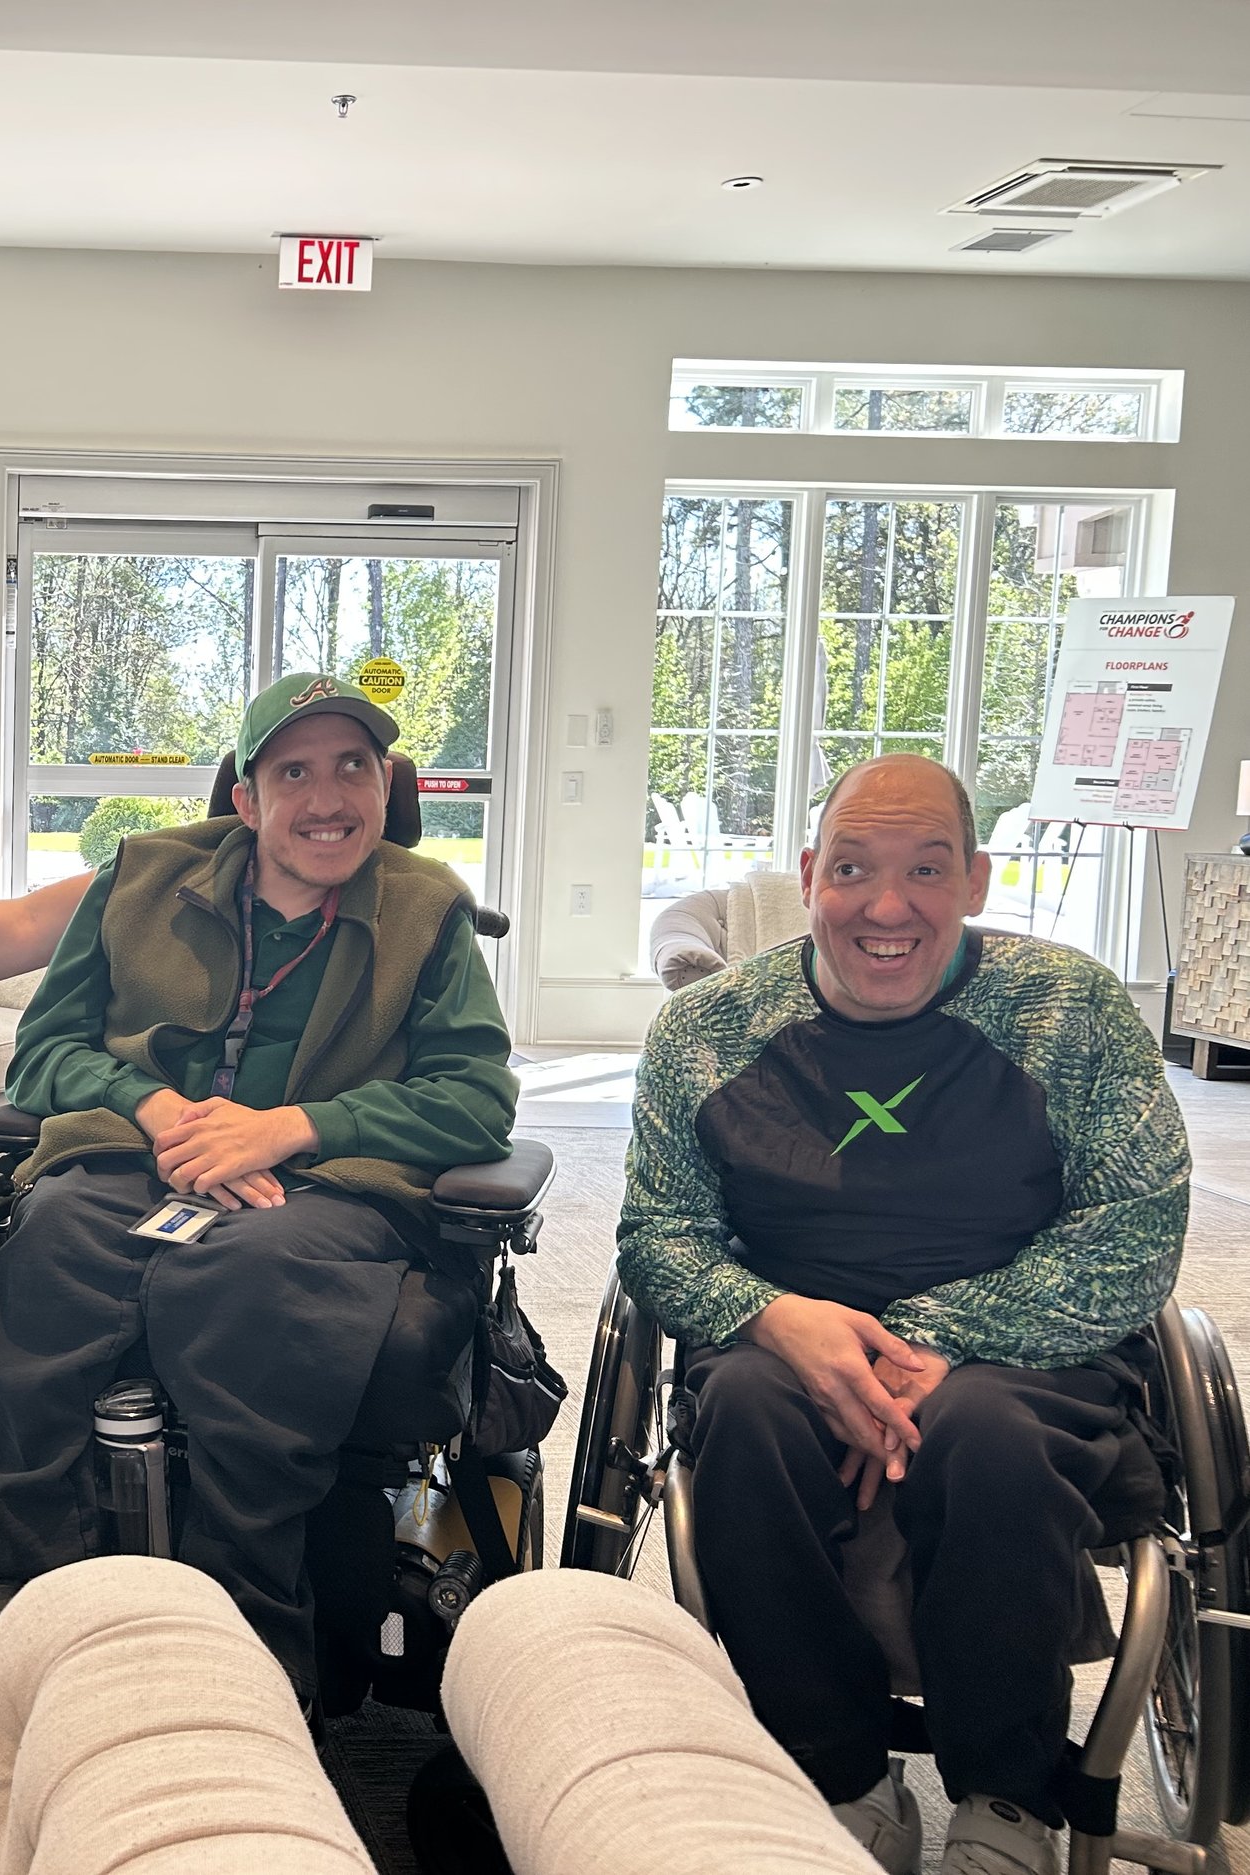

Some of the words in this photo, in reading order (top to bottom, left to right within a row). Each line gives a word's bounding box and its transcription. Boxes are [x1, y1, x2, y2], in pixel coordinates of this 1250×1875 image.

[297, 239, 360, 285] EXIT
[1099, 613, 1177, 625] CHAMPIONS
[1107, 626, 1163, 638] CHANGE
[1105, 661, 1168, 671] FLOORPLANS
[361, 676, 402, 686] CAUTION
[94, 755, 124, 764] AUTOMATIC
[125, 755, 139, 764] DOOR
[151, 756, 168, 764] STAND
[169, 756, 185, 764] CLEAR
[423, 780, 439, 789] PUSH
[439, 780, 447, 789] TO
[446, 780, 462, 789] OPEN
